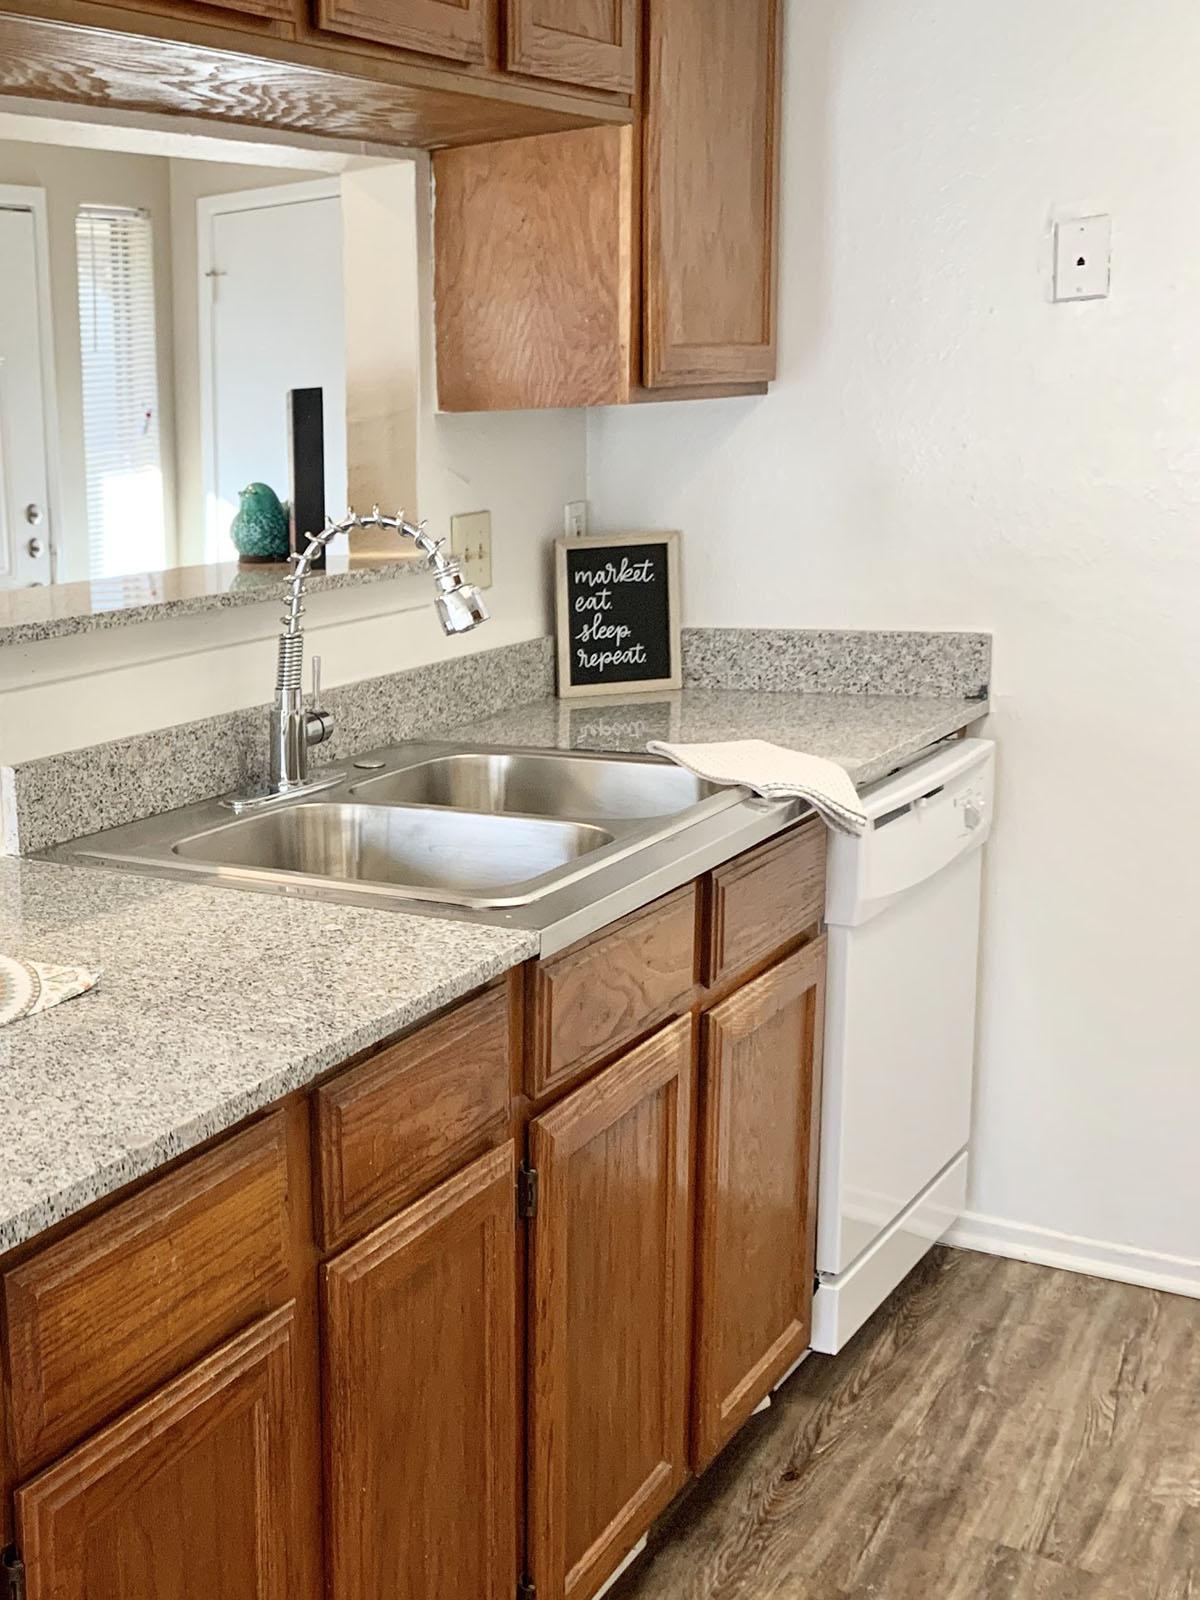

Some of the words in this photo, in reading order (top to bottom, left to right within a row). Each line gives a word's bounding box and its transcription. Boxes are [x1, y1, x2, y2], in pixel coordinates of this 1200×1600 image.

[574, 557, 655, 587] market.
[575, 588, 613, 612] eat.
[575, 613, 631, 647] sleep.
[576, 643, 647, 672] repeat.
